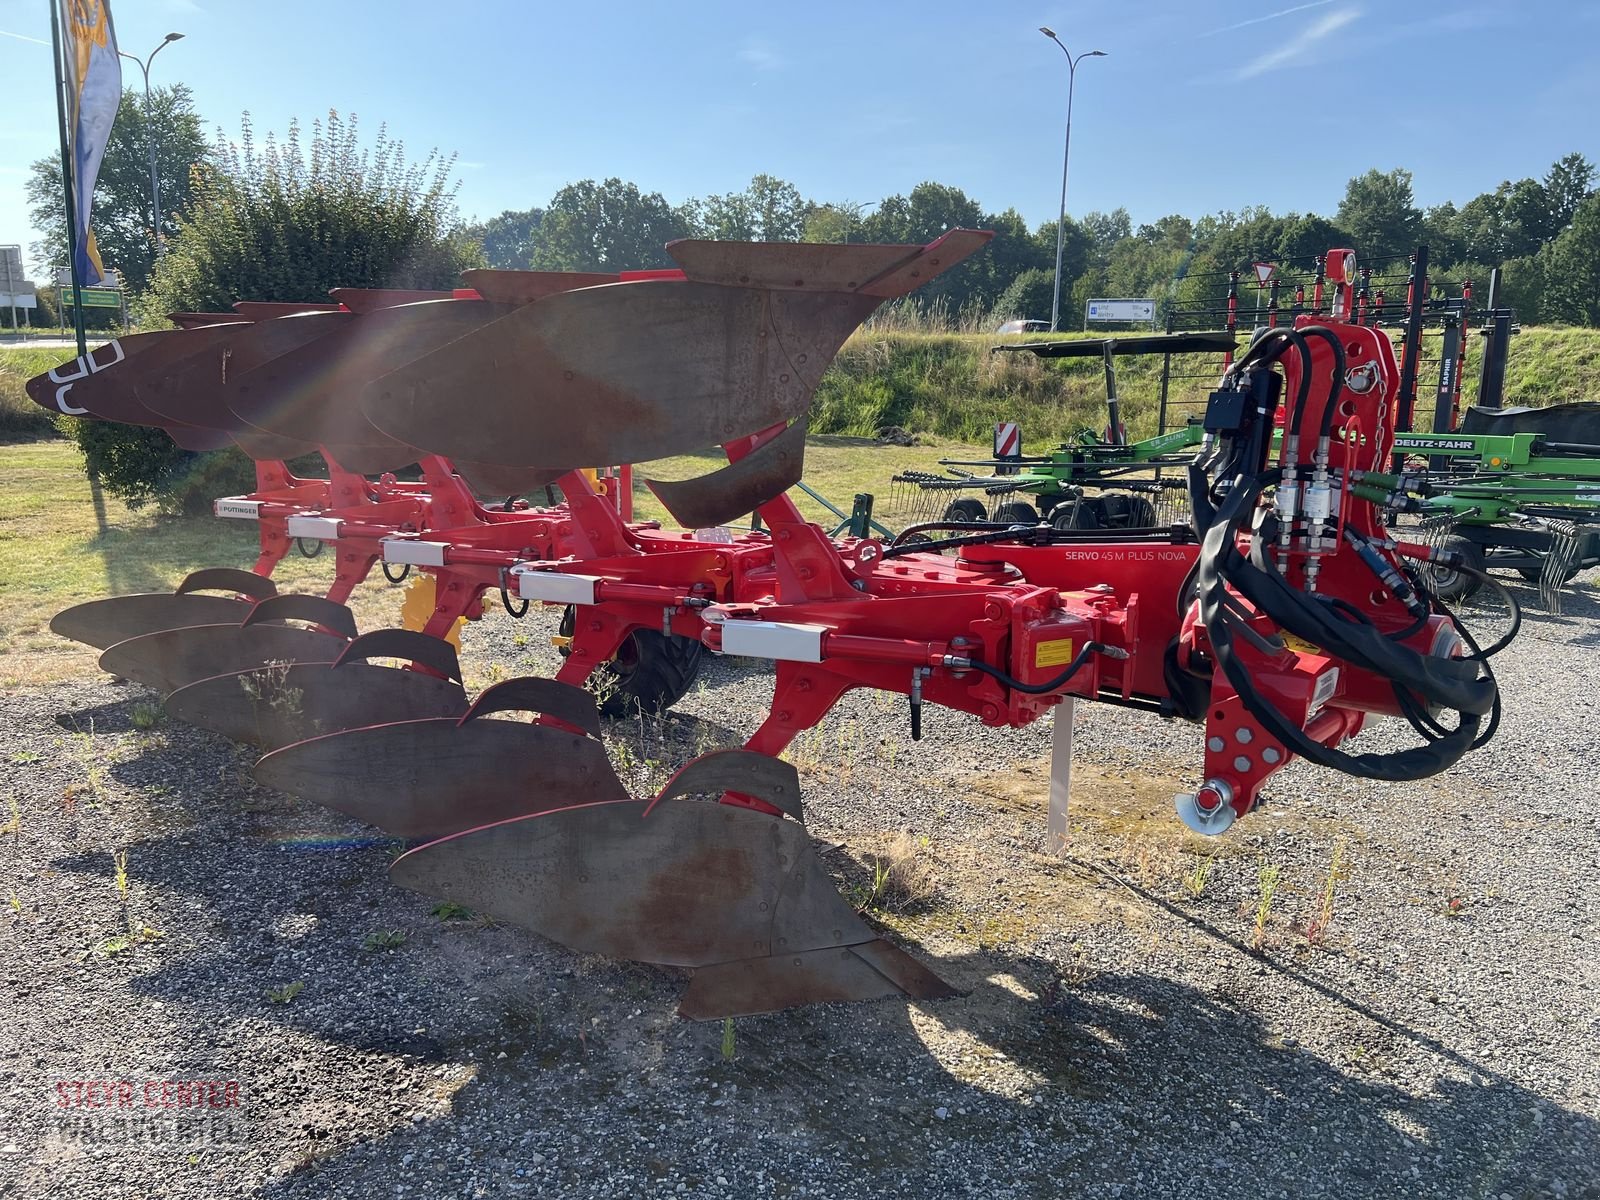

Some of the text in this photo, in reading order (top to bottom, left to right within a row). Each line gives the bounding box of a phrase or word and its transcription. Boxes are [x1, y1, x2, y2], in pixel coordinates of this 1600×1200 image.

[1442, 358, 1451, 385] SAPHIR
[1394, 439, 1473, 449] DEUTZ-FAHR
[1065, 551, 1099, 560] SERVO
[1128, 551, 1154, 560] PLUS
[1157, 551, 1186, 560] NOVA
